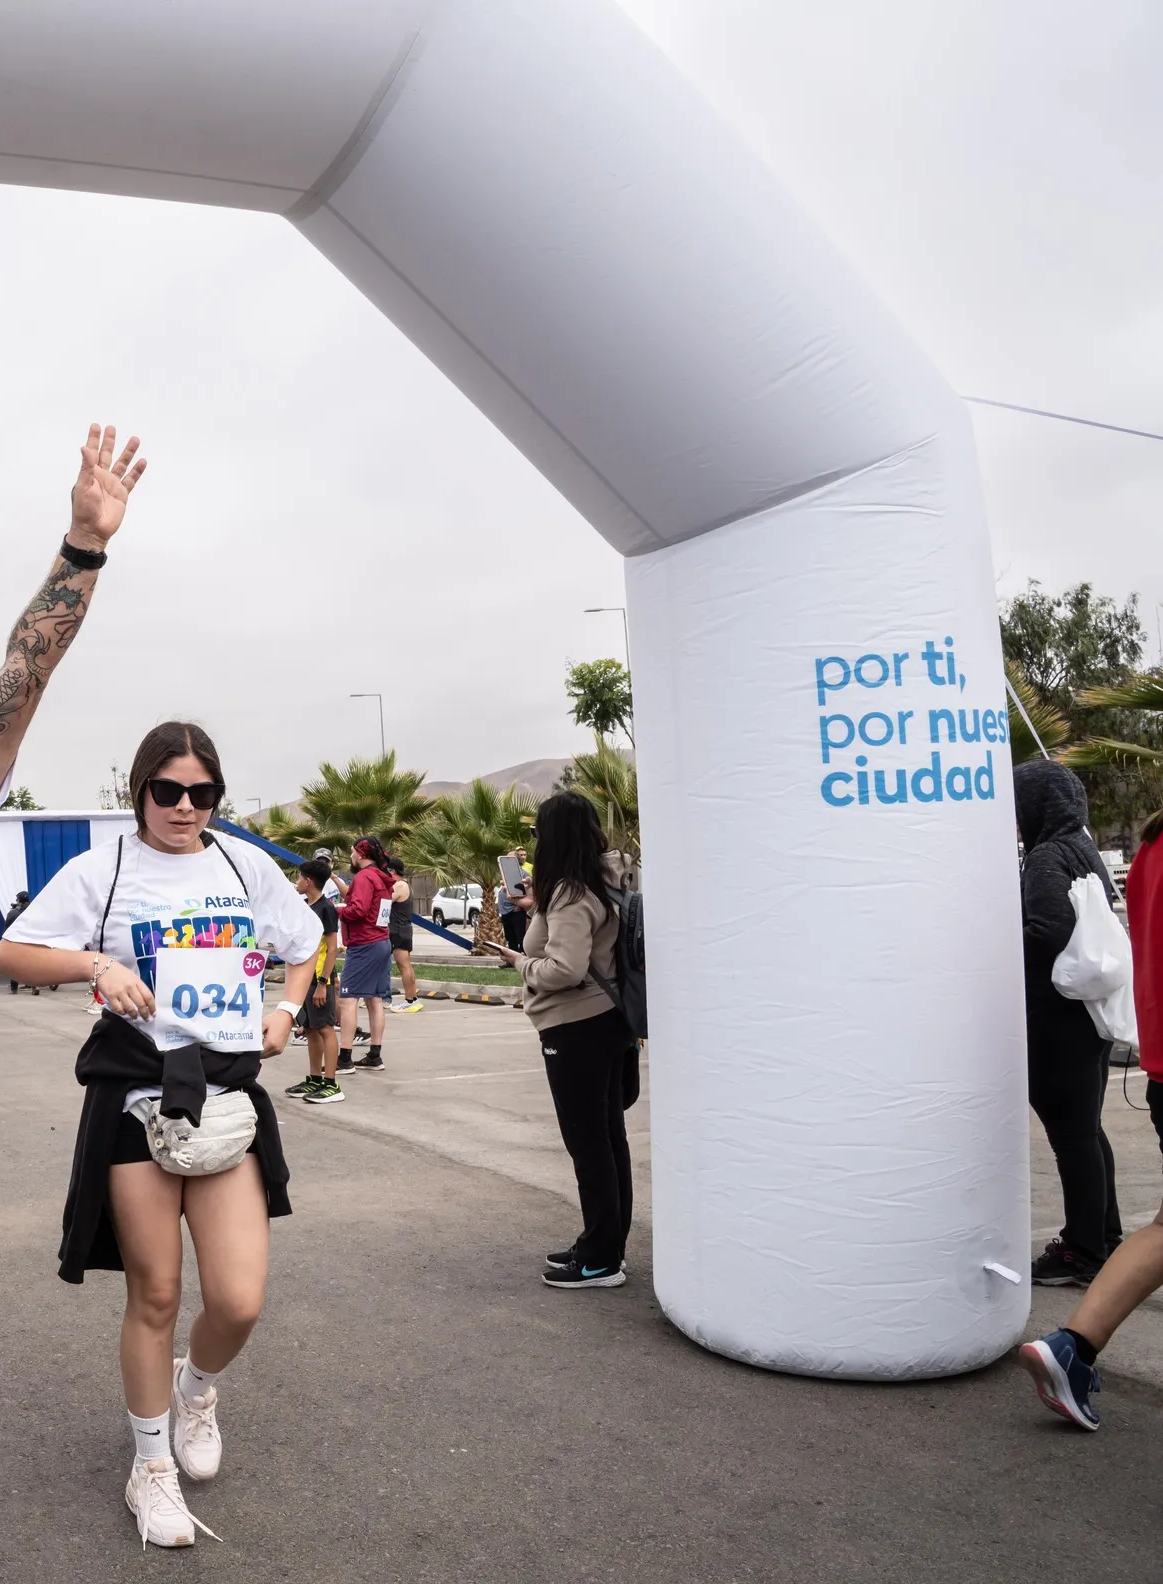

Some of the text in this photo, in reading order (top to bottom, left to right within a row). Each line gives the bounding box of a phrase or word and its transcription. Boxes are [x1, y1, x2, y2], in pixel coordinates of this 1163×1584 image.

[815, 636, 966, 706] por ti,
[819, 710, 914, 764] por
[820, 750, 995, 807] ciudad
[244, 957, 262, 970] 3K
[171, 983, 250, 1019] 034
[218, 1030, 254, 1041] Atacama
